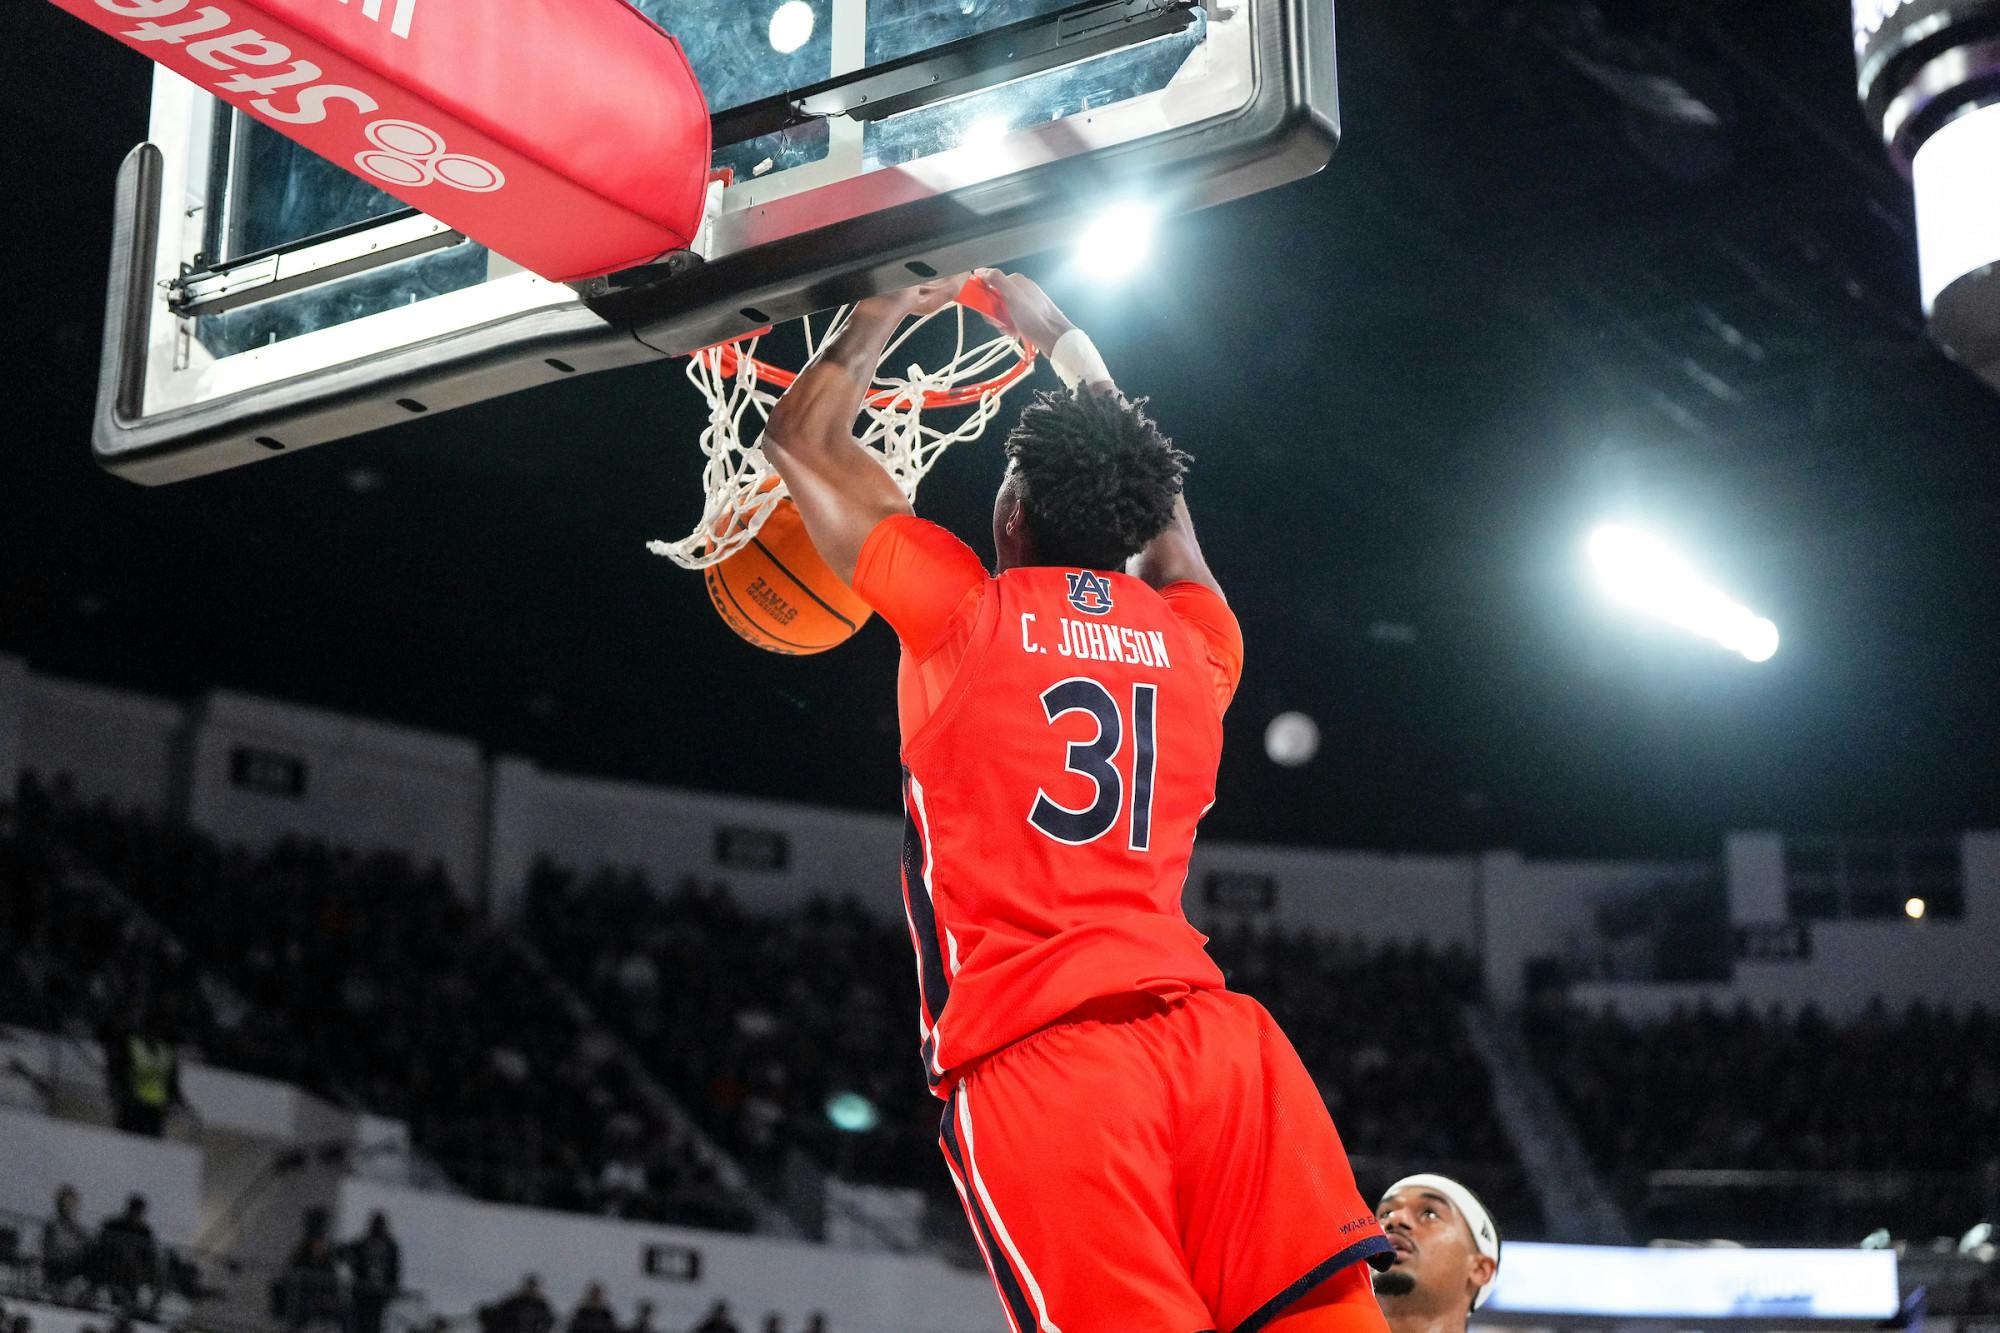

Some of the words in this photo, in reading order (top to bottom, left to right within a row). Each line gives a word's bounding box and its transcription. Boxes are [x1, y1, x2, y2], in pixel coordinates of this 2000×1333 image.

[752, 577, 796, 619] STATE
[1021, 613, 1048, 654] C.
[1057, 617, 1171, 669] JOHNSON
[1027, 676, 1158, 852] 31
